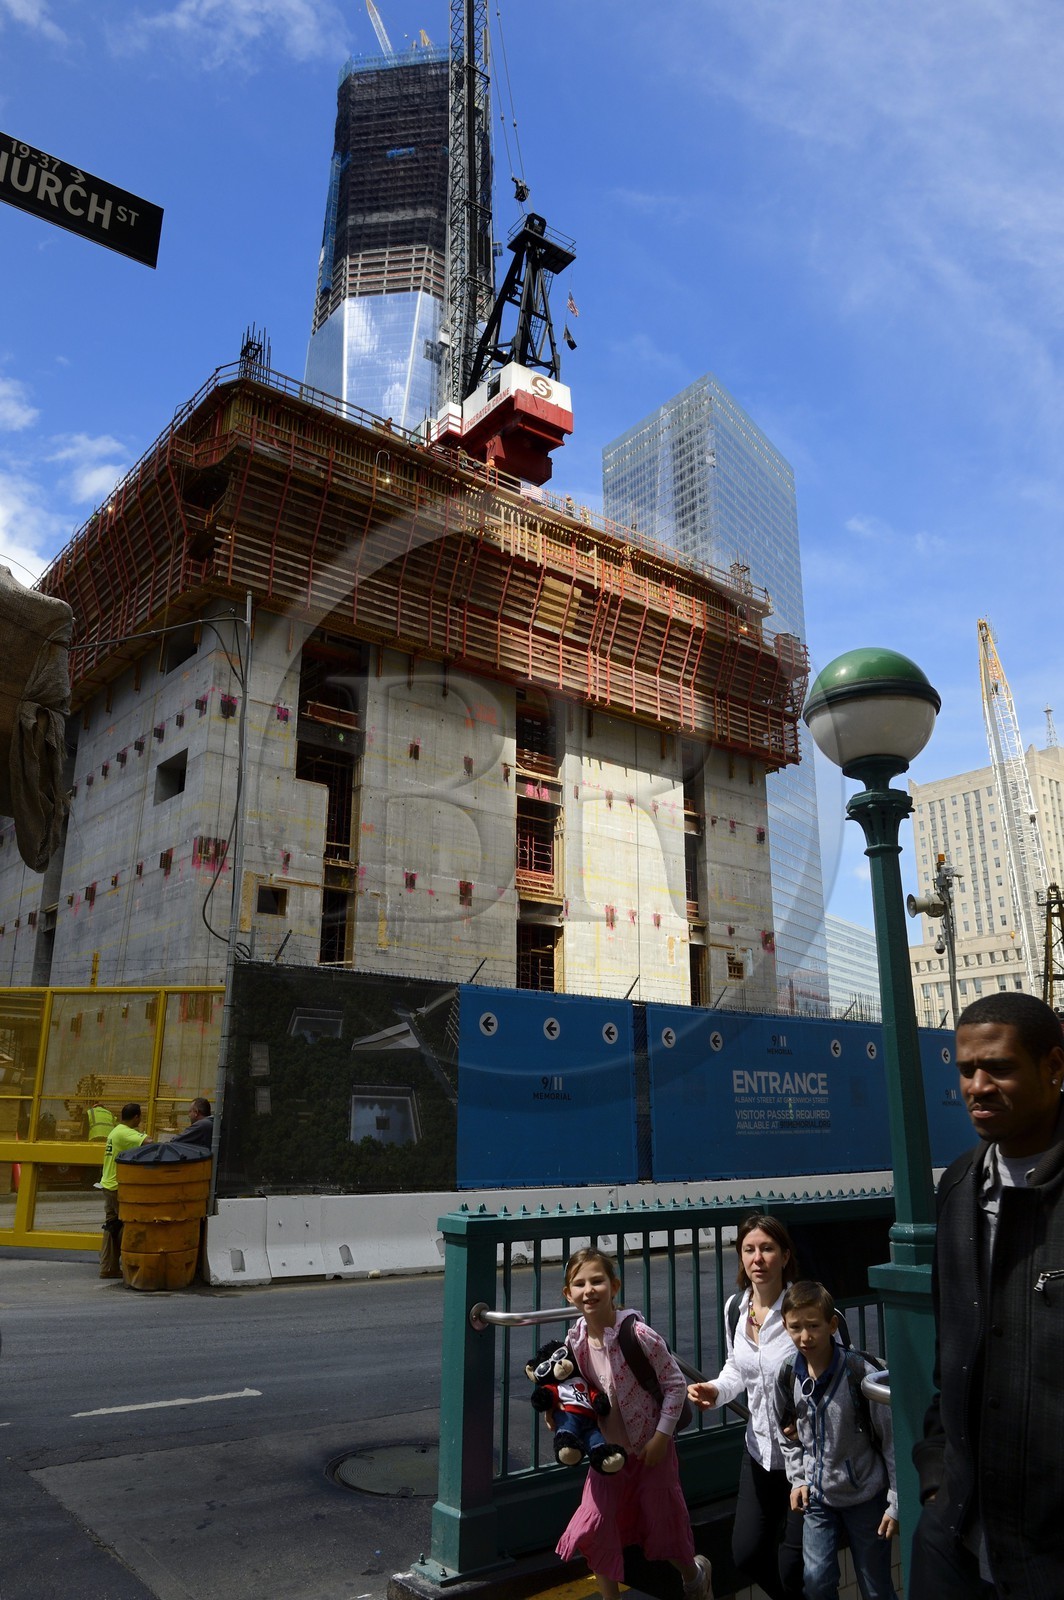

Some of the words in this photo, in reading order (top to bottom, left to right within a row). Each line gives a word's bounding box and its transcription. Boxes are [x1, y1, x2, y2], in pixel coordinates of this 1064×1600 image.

[11, 140, 61, 173] 19-37
[116, 205, 140, 227] ST
[732, 1070, 829, 1095] ENTRANCE
[533, 1092, 571, 1101] MEMORIAL
[734, 1096, 756, 1104] ALBANY
[757, 1096, 775, 1104] STREET
[812, 1096, 829, 1104] STREET
[735, 1109, 766, 1120] VISITOR
[767, 1109, 794, 1120] PASSES
[796, 1109, 831, 1120] REQUIRED
[736, 1120, 770, 1130] AVAILABLE
[771, 1120, 779, 1129] AT
[576, 1392, 589, 1402] NY
